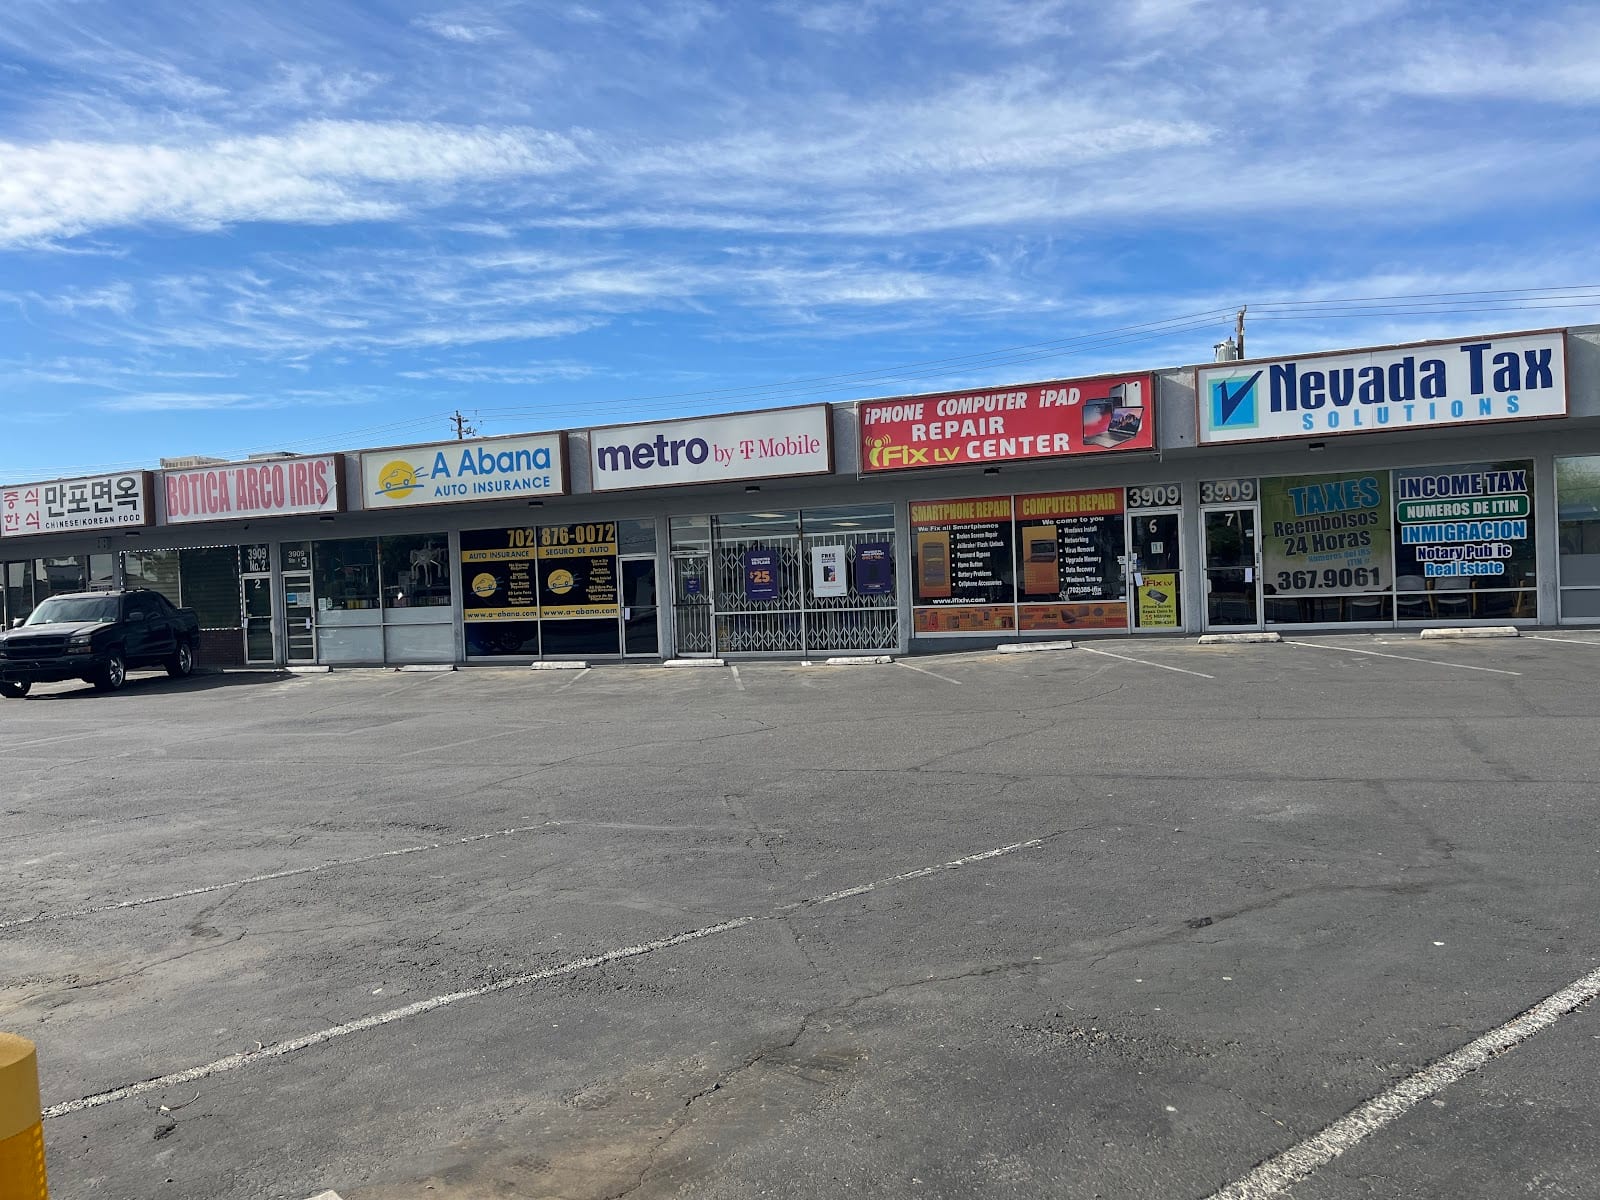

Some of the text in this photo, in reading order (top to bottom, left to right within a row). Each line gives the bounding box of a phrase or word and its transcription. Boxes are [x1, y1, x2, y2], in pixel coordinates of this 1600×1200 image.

[1269, 343, 1553, 413] Nevada Tax
[865, 388, 1080, 424] iPHONE COMPUTER iPAD
[1302, 395, 1520, 430] SOLUTIONS
[912, 417, 1005, 442] REPAIR
[598, 434, 709, 472] metro
[714, 445, 735, 467] by
[758, 435, 820, 458] Mobile
[967, 433, 1070, 459] CENTER
[431, 447, 551, 480] A Abana
[167, 471, 231, 516] BOTICA
[434, 476, 551, 497] AUTO INSURANCE
[1202, 481, 1254, 502] 3909
[1400, 470, 1528, 499] INCOME TAX
[45, 477, 140, 518] 만포면옥
[1022, 492, 1116, 516] COMPUTER REPAIR
[1129, 486, 1179, 507] 3909
[1288, 477, 1380, 516] TAXES
[119, 514, 140, 522] FOOD
[912, 500, 1010, 522] SMARTPHONE REPAIR
[1407, 500, 1519, 518] NUMEROS DE ITIN
[953, 523, 999, 531] Smartphones
[1090, 516, 1104, 524] you
[1149, 519, 1158, 534] 6
[1225, 513, 1234, 527] 7
[1274, 512, 1378, 537] Reembolsos
[507, 524, 615, 548] 702 876-0072
[1402, 520, 1526, 544] INMIGRACION
[546, 548, 574, 556] SEGURO
[1284, 530, 1372, 556] 24 Horas
[1417, 546, 1464, 560] Notary
[248, 548, 266, 560] 3909
[302, 556, 308, 568] 3
[490, 550, 530, 558] INSURANCE
[1278, 566, 1380, 590] 367.9061
[1425, 561, 1504, 576] Real Estate
[254, 580, 261, 588] 2
[467, 610, 537, 618] www.a-abana.com
[544, 608, 618, 616] www.a-abana.com
